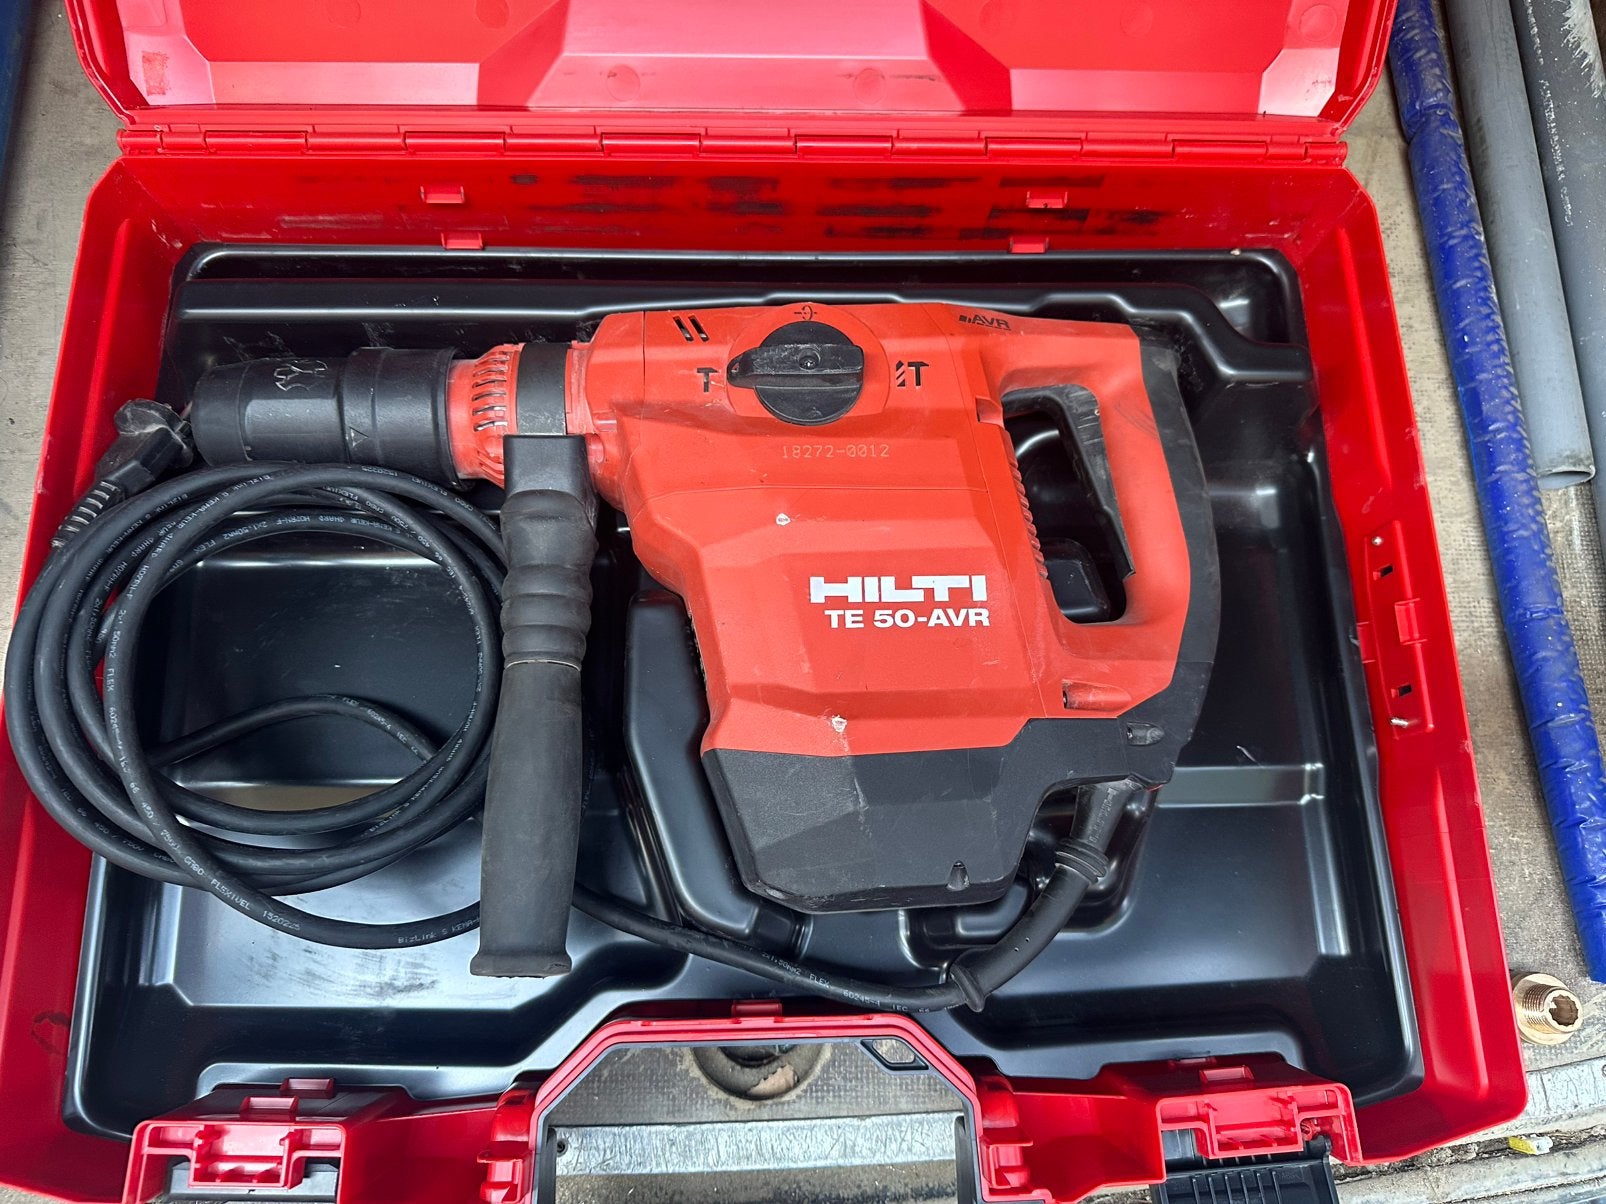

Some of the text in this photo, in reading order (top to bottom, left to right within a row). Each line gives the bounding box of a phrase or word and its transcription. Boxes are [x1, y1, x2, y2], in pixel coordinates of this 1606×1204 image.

[972, 314, 1011, 330] AVR
[782, 444, 890, 458] 18272-0012
[809, 575, 988, 604] HILTI
[824, 608, 990, 629] TE 50-AVR
[106, 668, 116, 693] FLEX
[397, 931, 438, 945] BizLink
[808, 973, 832, 988] FLEX
